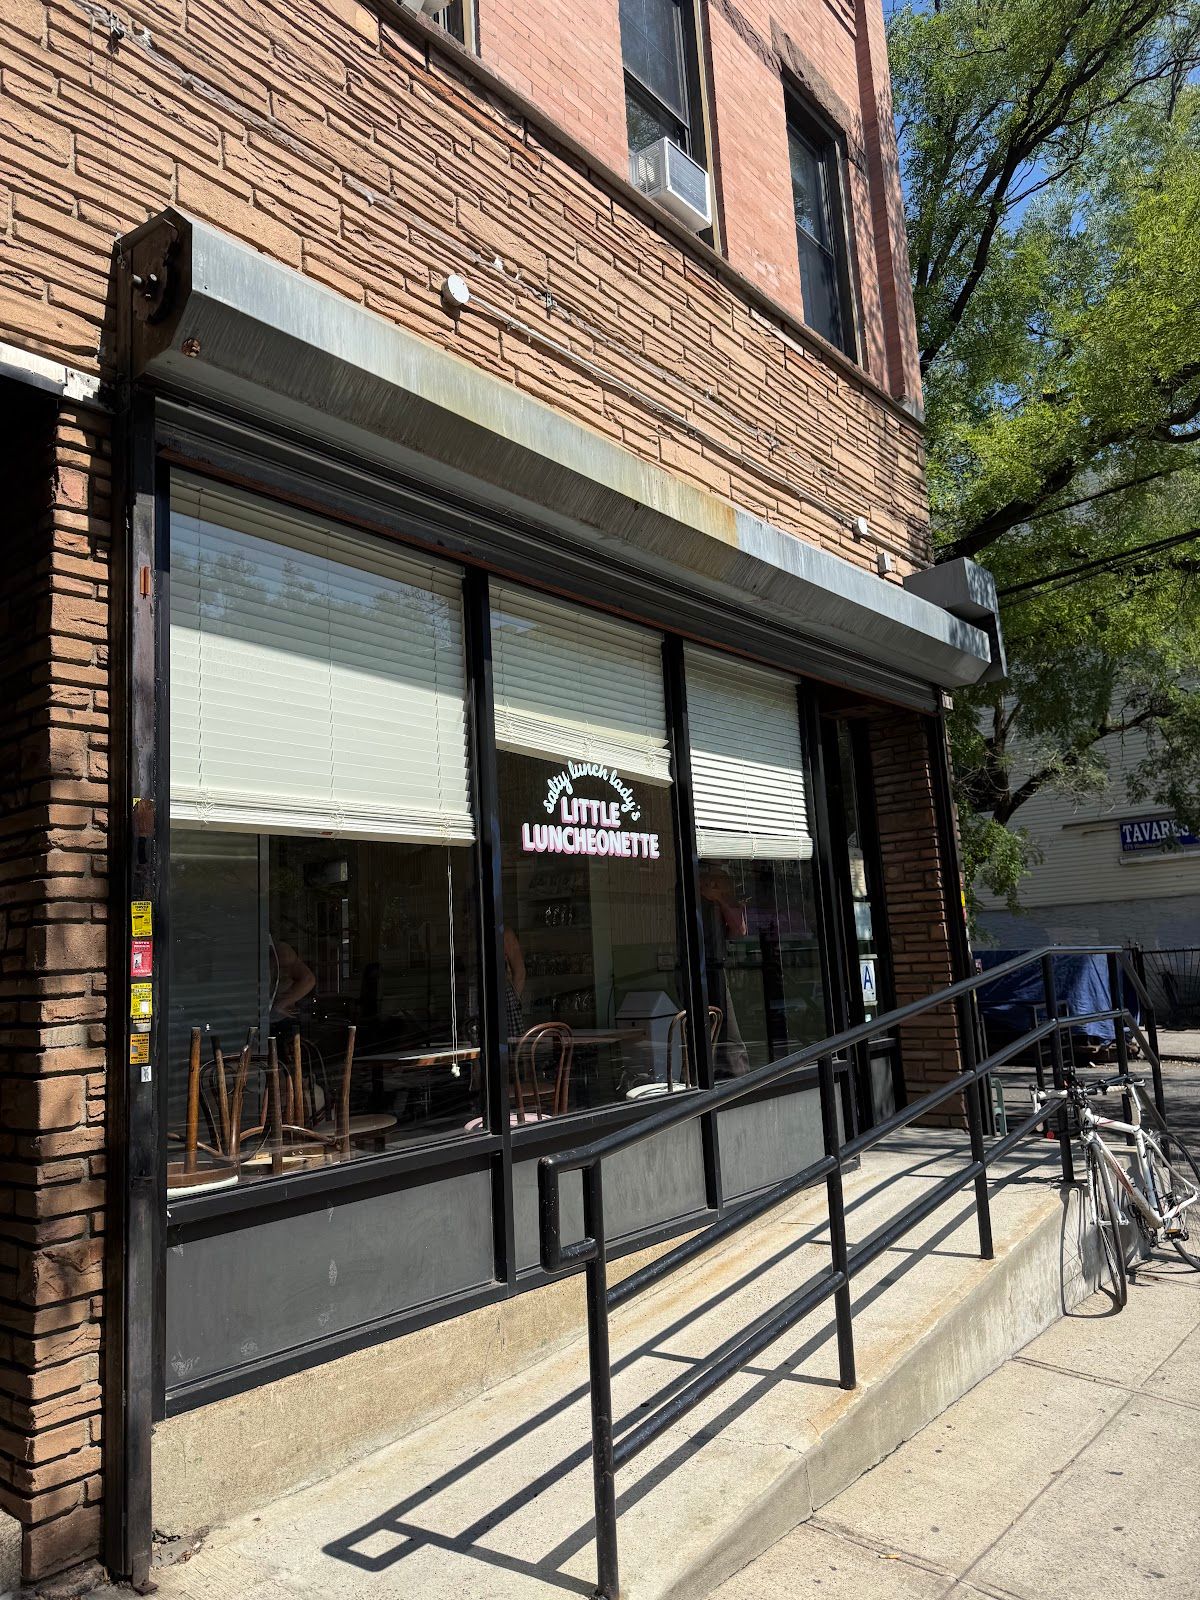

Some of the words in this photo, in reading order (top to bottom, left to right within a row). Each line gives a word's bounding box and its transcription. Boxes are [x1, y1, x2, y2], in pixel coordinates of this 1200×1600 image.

[543, 771, 573, 813] salty
[568, 760, 610, 780] lunch
[609, 769, 641, 821] lady's
[560, 796, 621, 828] LITTLE
[522, 823, 660, 859] LUNCHEONETTE
[863, 965, 873, 989] A
